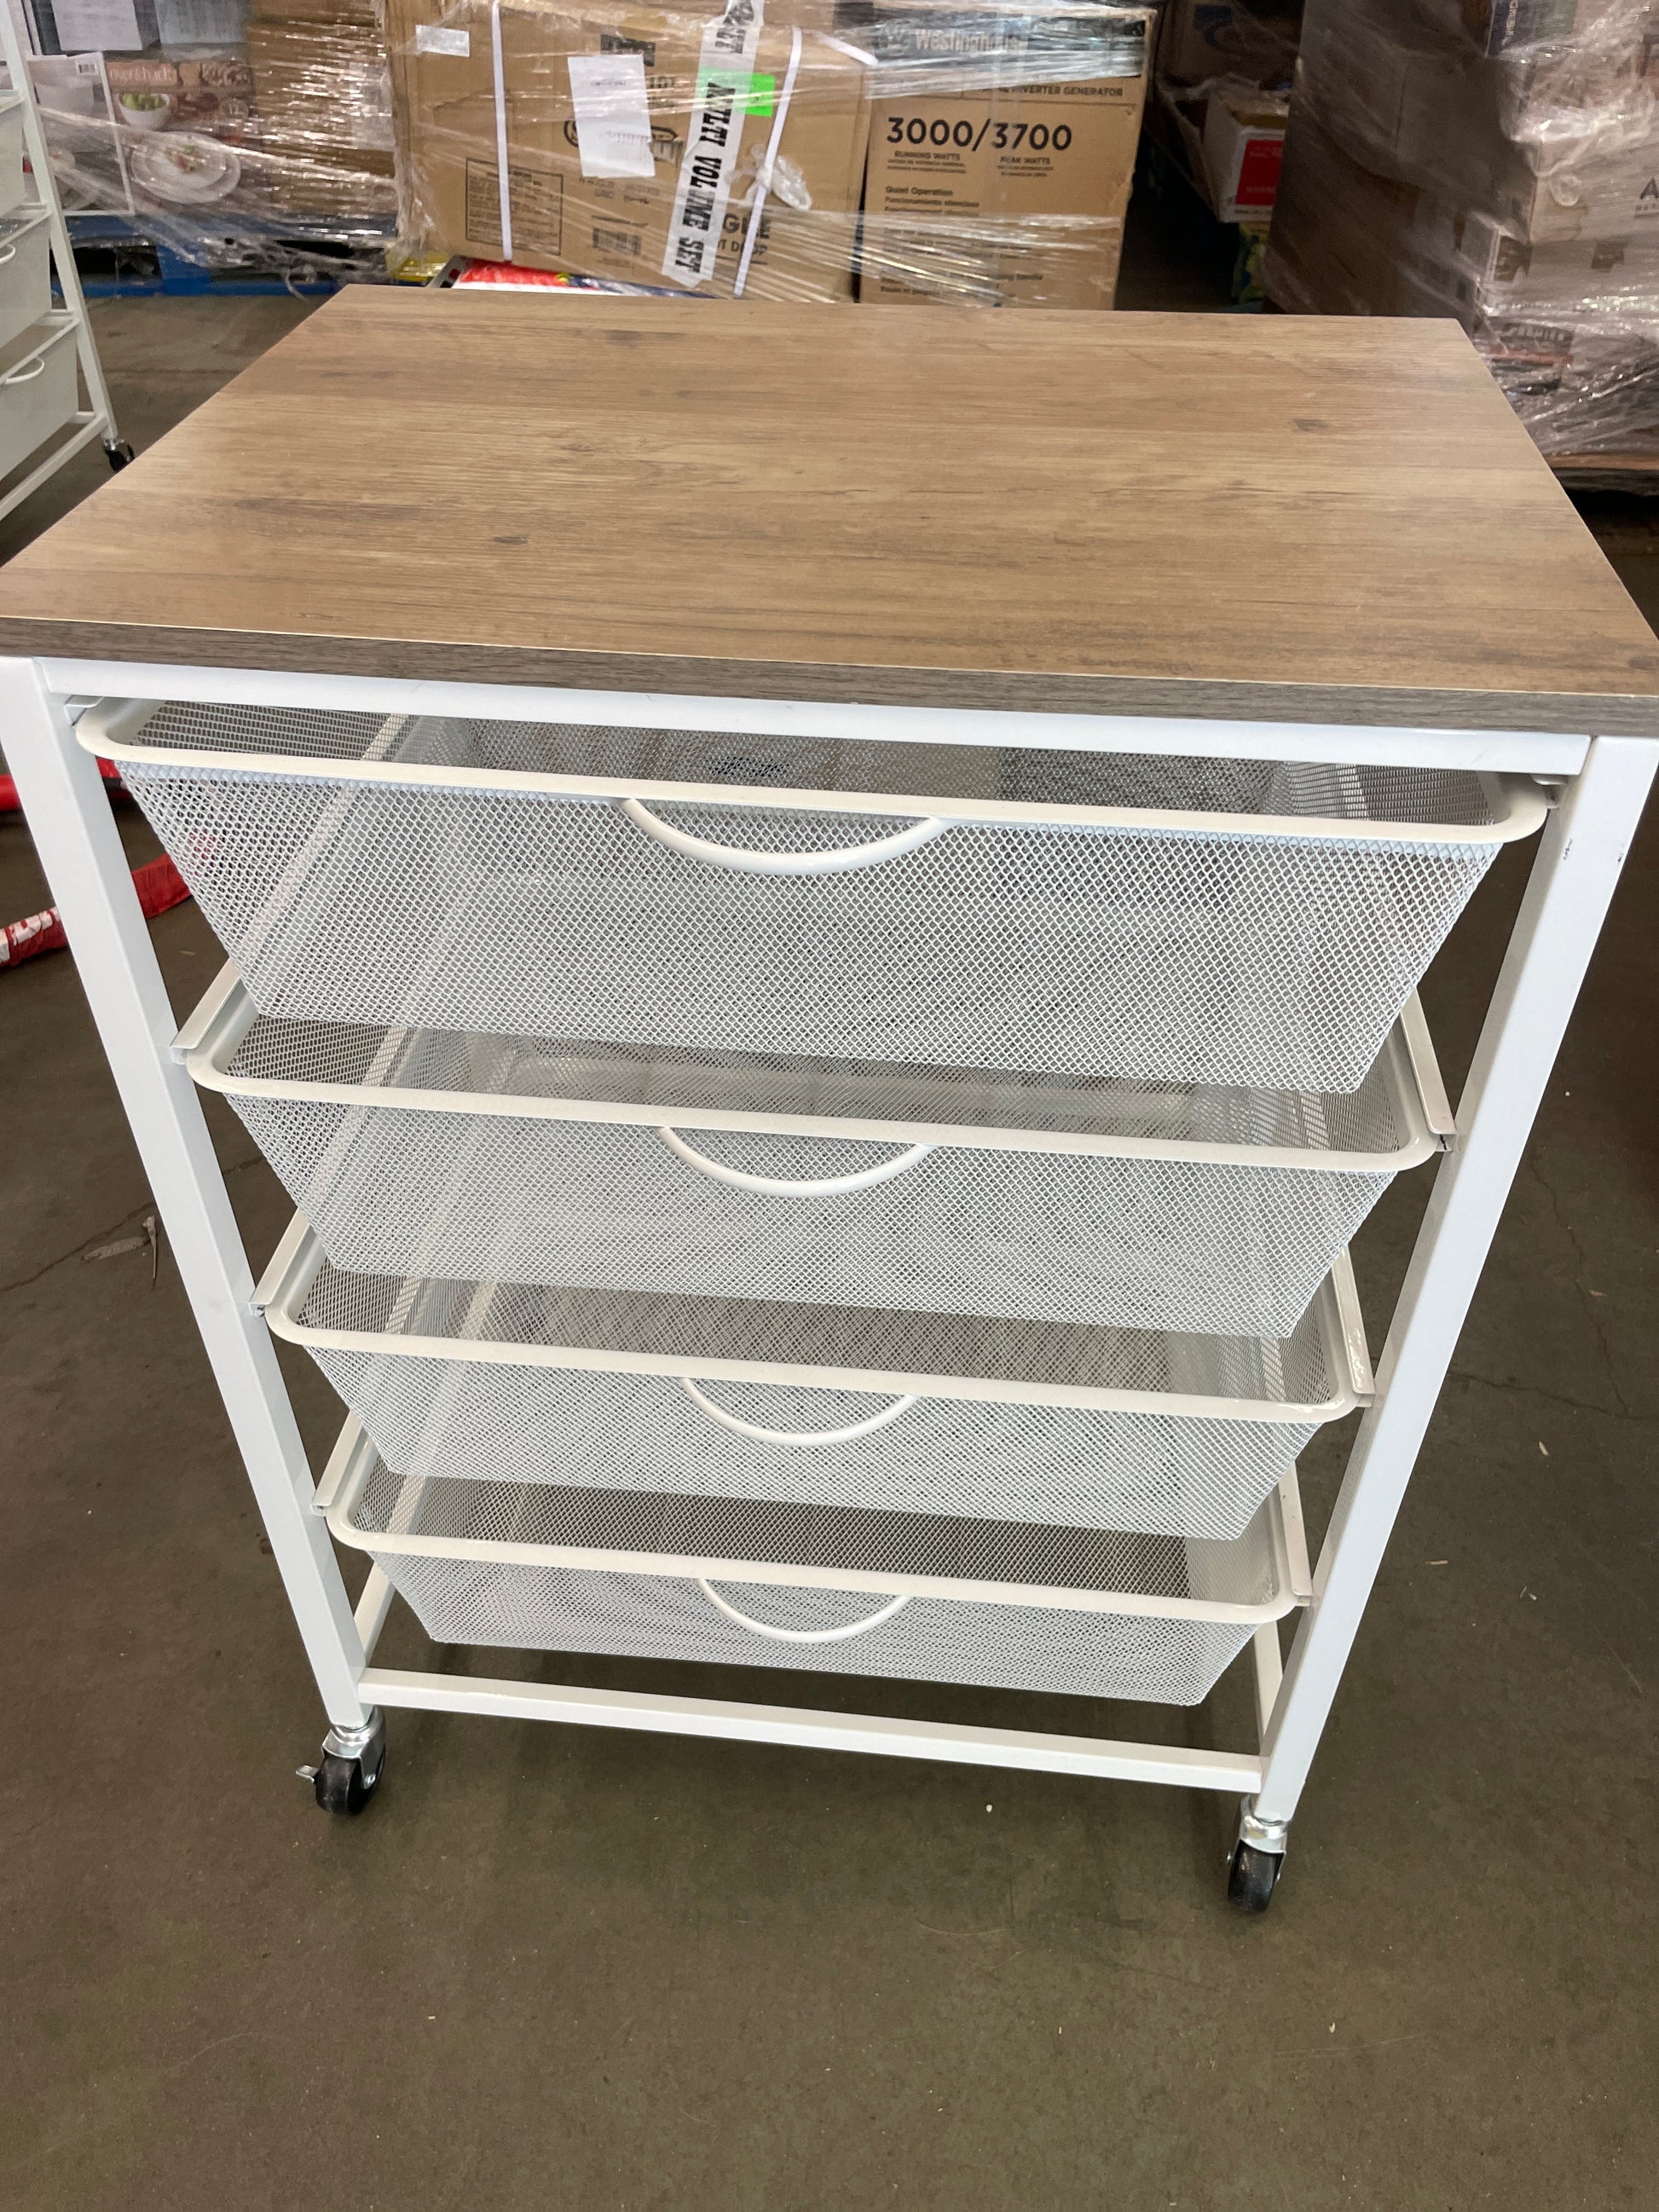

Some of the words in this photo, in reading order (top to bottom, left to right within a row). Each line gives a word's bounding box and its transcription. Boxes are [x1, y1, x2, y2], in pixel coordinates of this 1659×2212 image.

[1063, 86, 1123, 97] GENERATOR
[699, 82, 736, 147] MULTI
[887, 117, 1072, 152] 3000/3700
[934, 153, 961, 161] WATTS
[683, 155, 722, 231] VOLUME
[675, 238, 704, 274] SET
